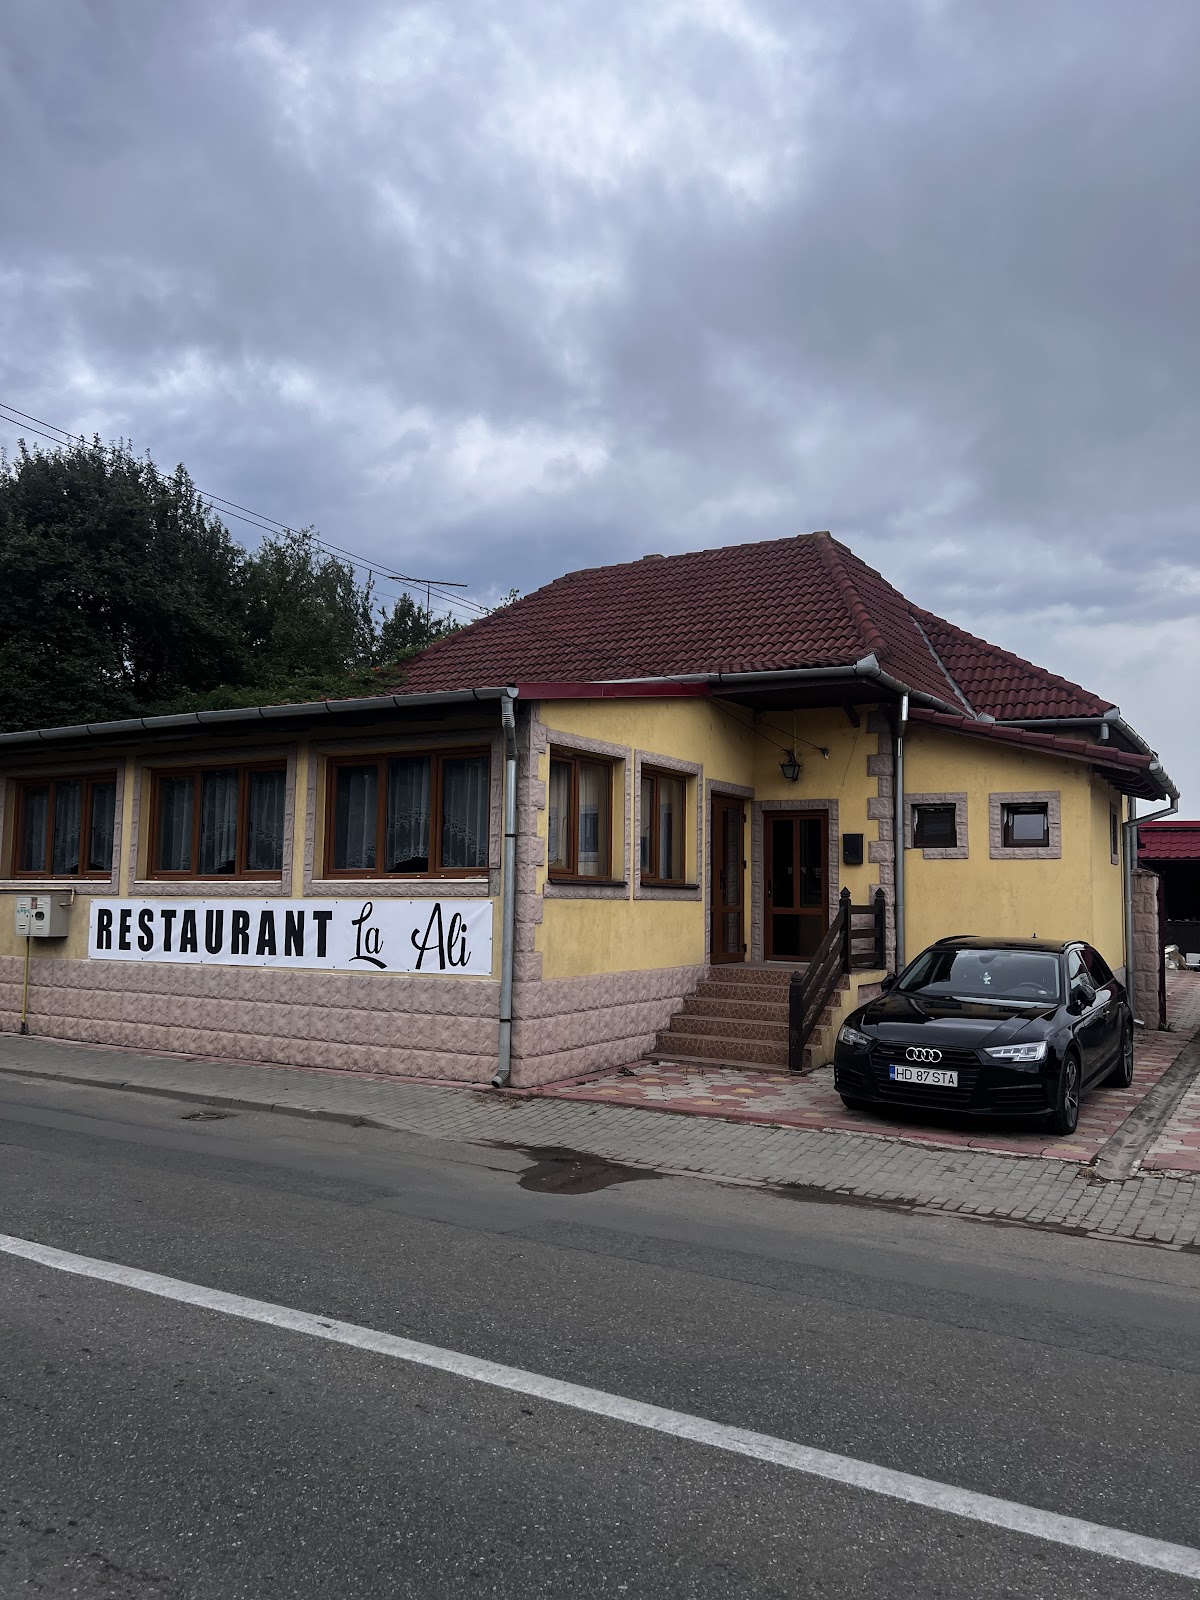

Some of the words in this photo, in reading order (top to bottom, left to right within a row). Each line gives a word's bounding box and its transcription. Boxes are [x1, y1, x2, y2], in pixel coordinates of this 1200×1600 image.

[96, 908, 333, 958] RESTAURANT
[348, 901, 388, 970] La
[410, 902, 472, 970] Ali
[896, 1067, 912, 1080] HD
[916, 1070, 930, 1082] 87
[932, 1071, 955, 1085] STA
